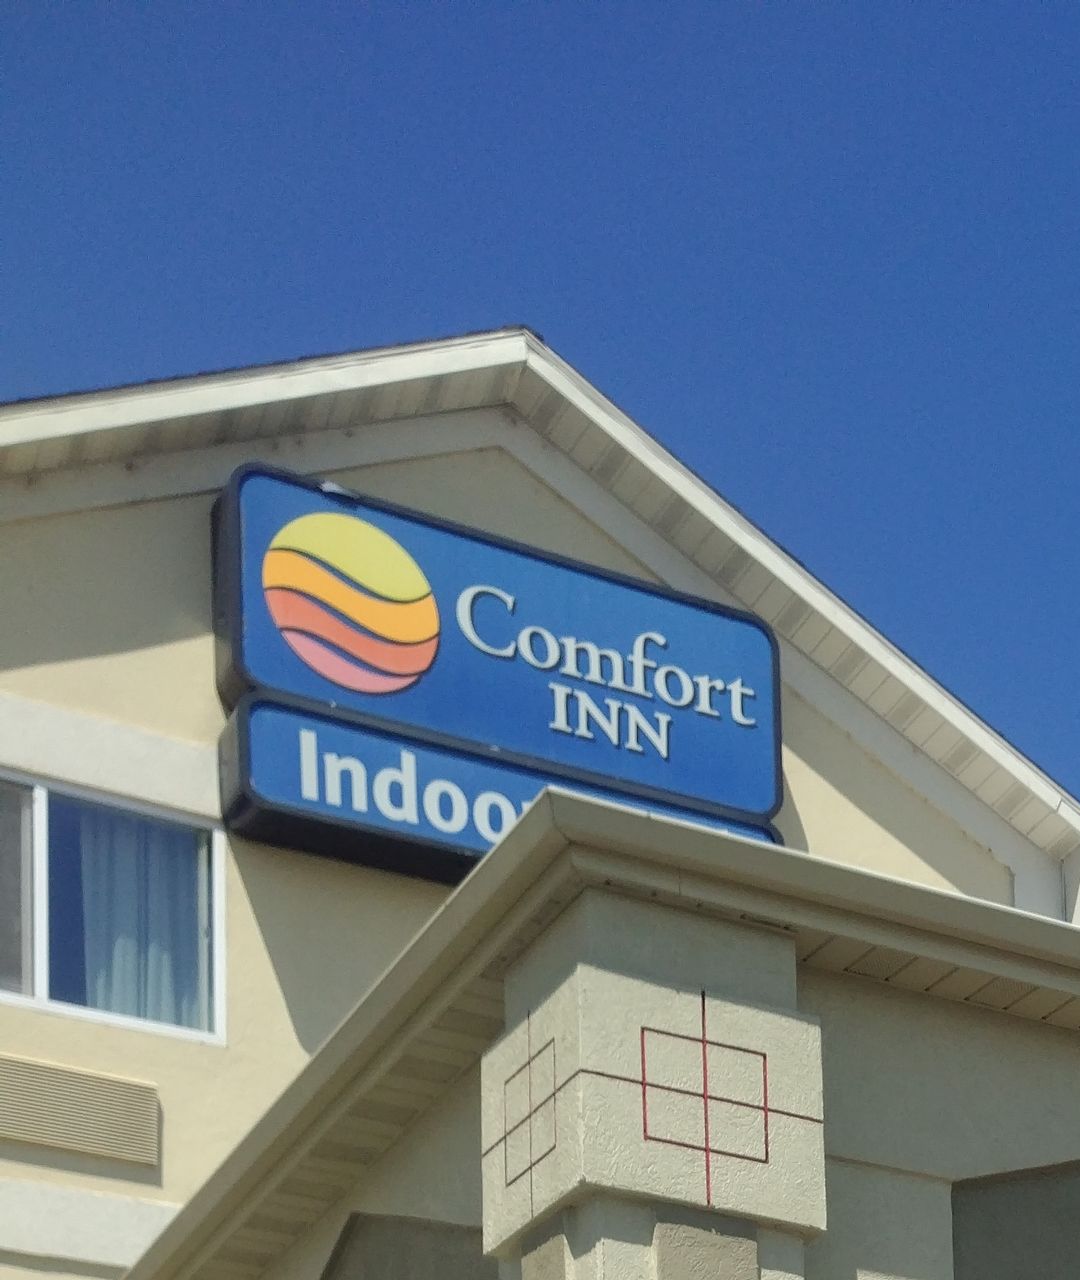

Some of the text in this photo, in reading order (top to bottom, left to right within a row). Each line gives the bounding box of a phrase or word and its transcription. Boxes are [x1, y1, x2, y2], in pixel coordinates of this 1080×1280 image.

[455, 584, 756, 726] Comfort
[548, 682, 672, 760] INN
[299, 729, 532, 844] Indoo
